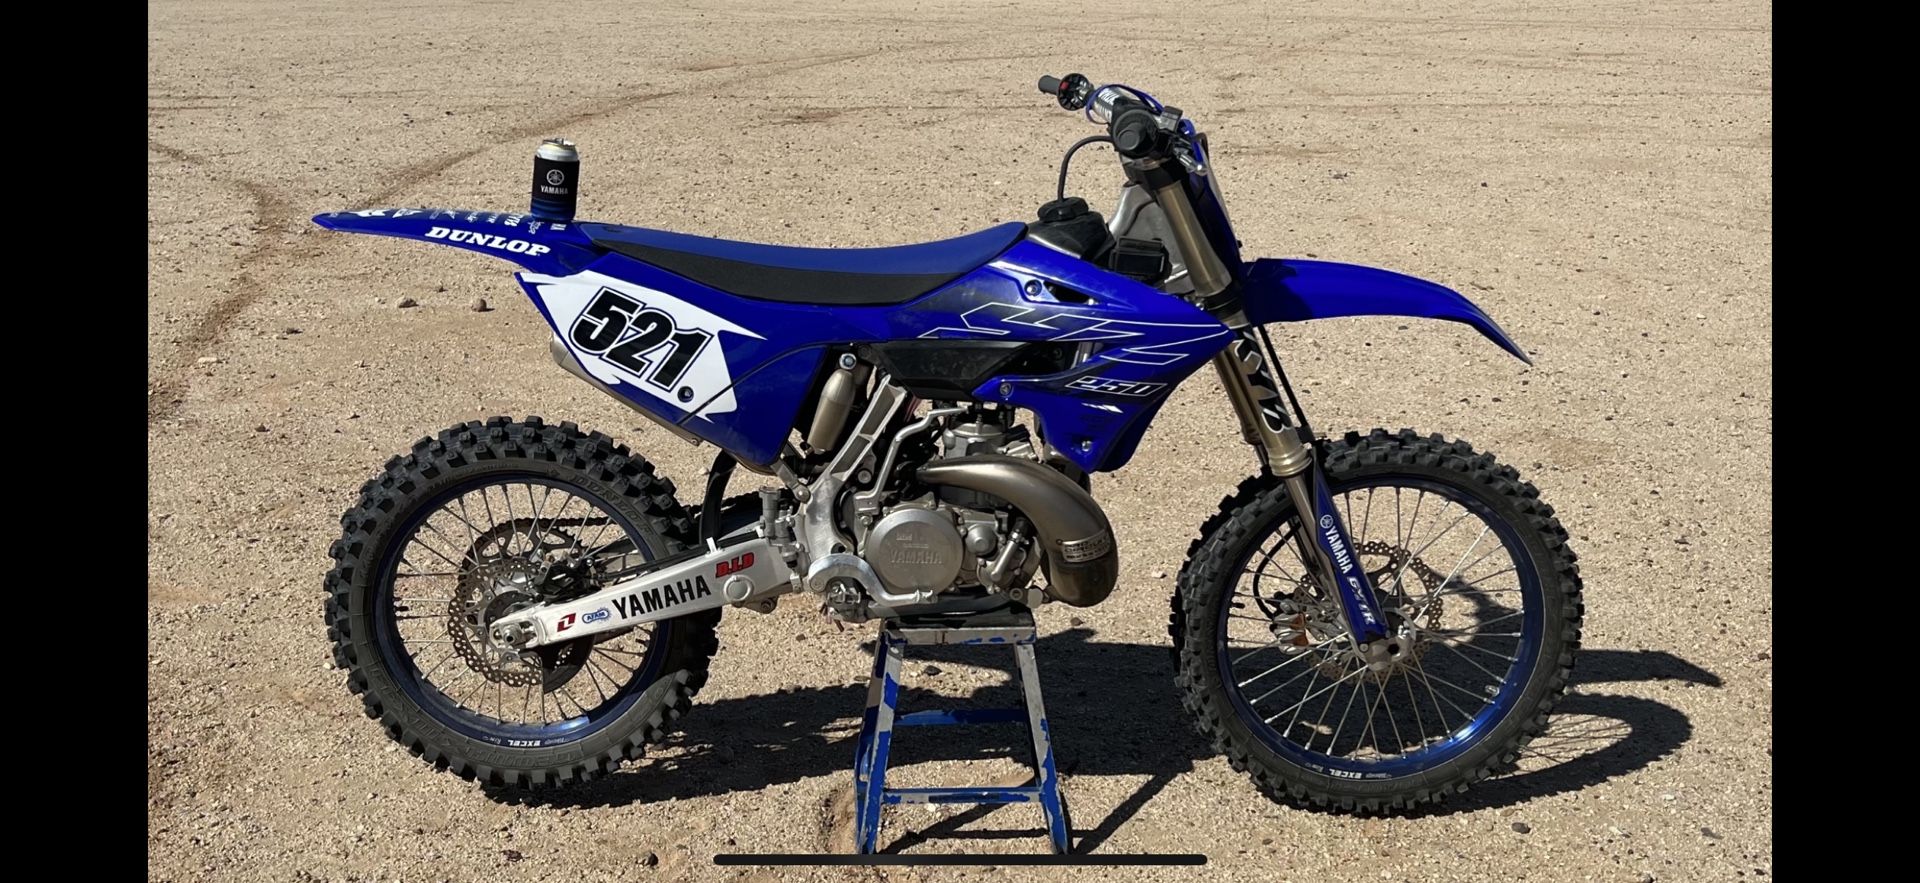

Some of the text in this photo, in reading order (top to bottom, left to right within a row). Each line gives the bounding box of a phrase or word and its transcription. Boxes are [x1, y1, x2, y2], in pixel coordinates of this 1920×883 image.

[540, 184, 569, 196] YAMAHA
[424, 226, 551, 257] DUNLOP
[569, 286, 714, 393] 521
[1064, 375, 1168, 397] 250
[888, 549, 944, 564] YAMAHA
[1325, 525, 1354, 575] YAMAHA
[611, 574, 712, 620] YAMAHA
[507, 739, 541, 748] EXCEL
[1328, 767, 1363, 780] EXCEL
